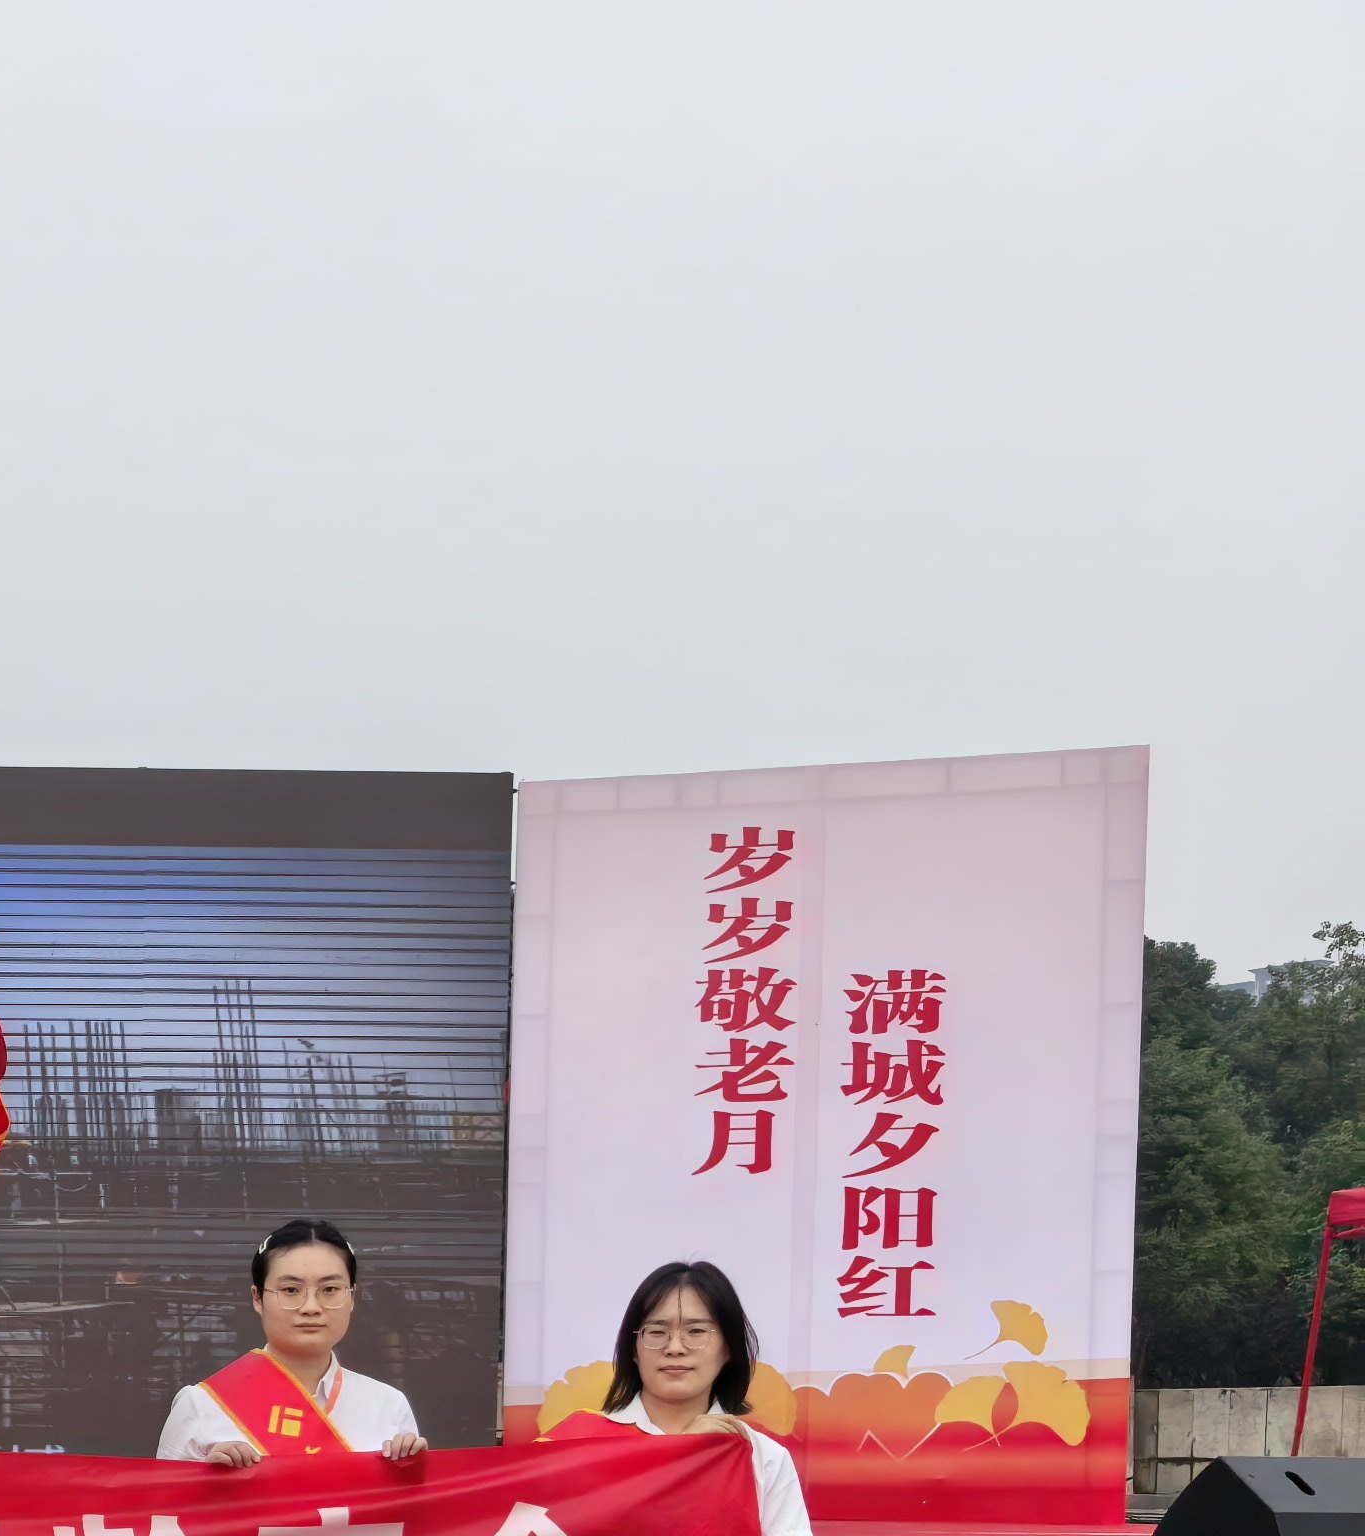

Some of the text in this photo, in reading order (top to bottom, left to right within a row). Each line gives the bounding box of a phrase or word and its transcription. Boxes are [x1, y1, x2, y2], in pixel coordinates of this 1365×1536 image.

[691, 826, 798, 1176] 岁岁敬老月
[836, 968, 948, 1319] 满城夕阳红
